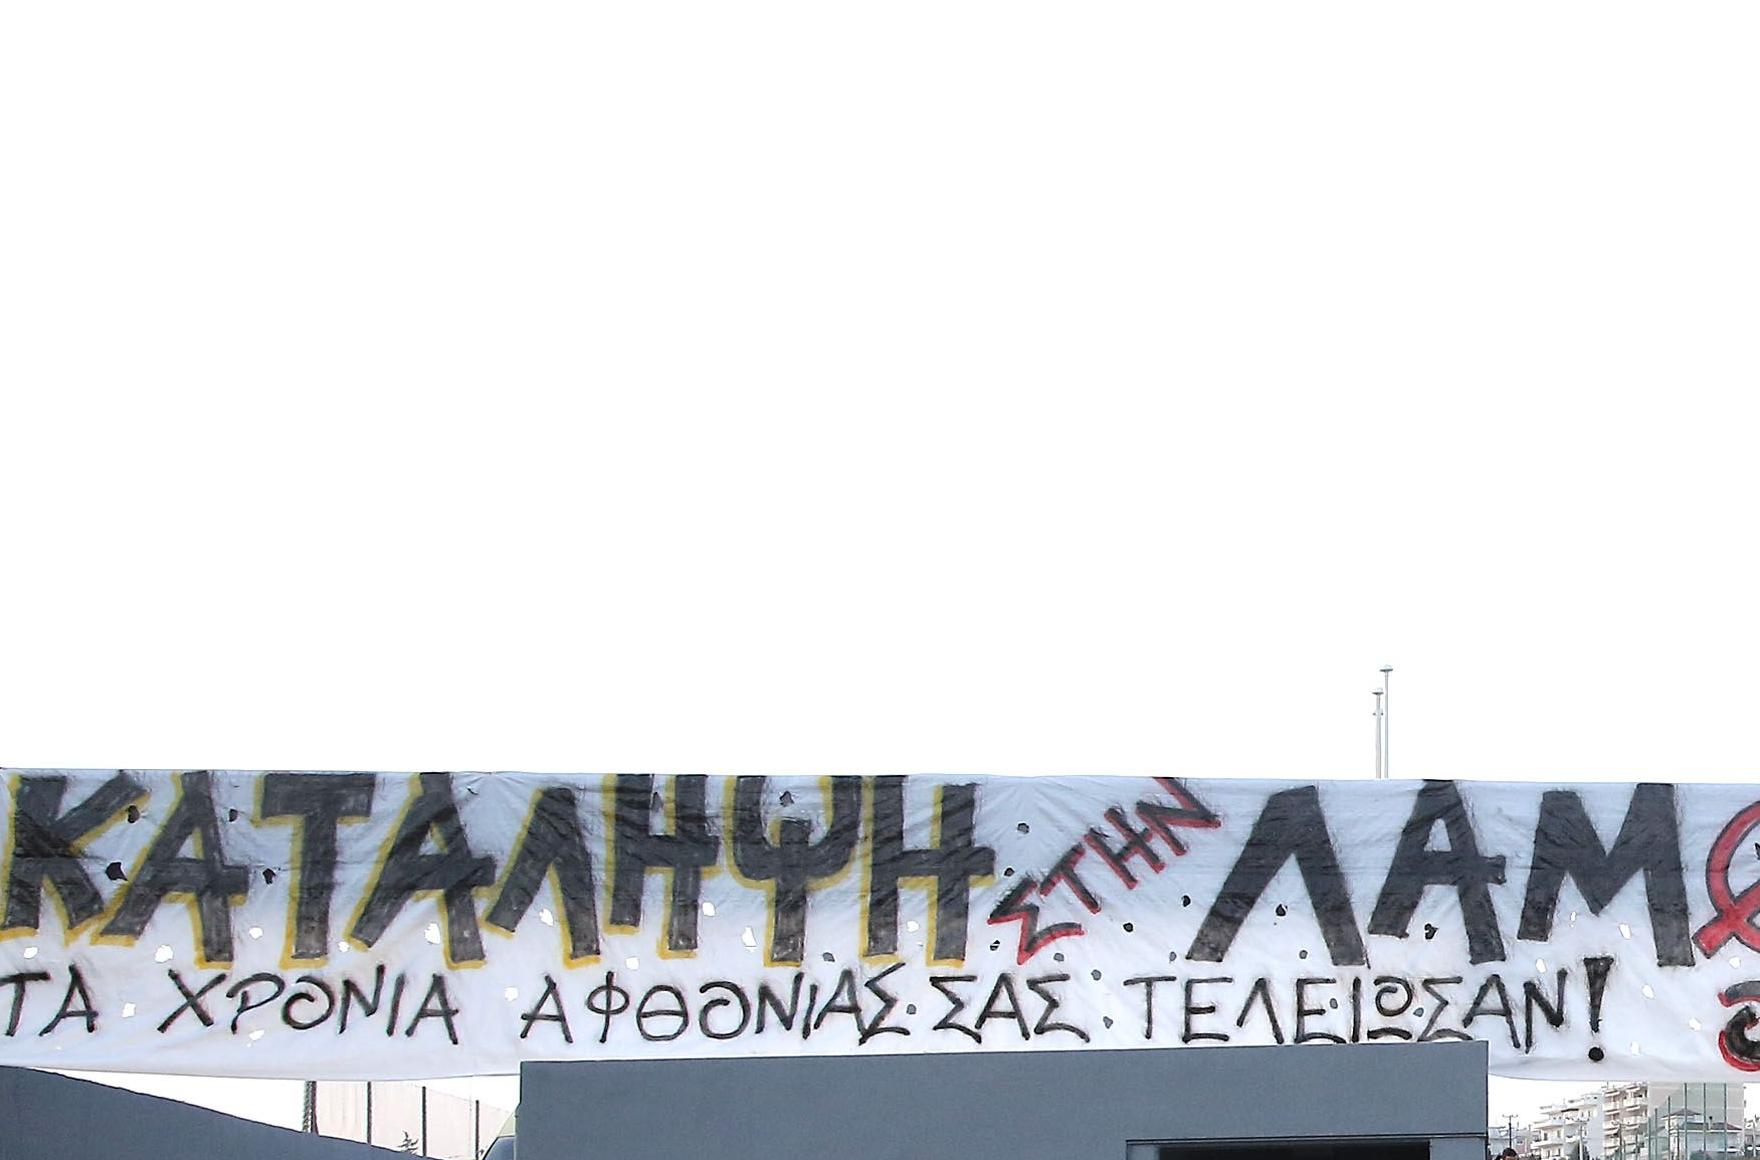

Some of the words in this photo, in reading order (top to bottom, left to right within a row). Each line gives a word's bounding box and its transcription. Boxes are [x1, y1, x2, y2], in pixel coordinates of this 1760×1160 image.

[0, 772, 995, 969] ΚΑΤΑΛΗΨΗ
[988, 777, 1222, 964] ΣΤΗΝ
[0, 961, 99, 1037] ΤΑ
[157, 965, 460, 1045] ΧΡΟΝΙΑ
[520, 962, 911, 1046] ΑΦΘΟΝΙΑΣ
[929, 972, 1091, 1044] ΣΑΣ
